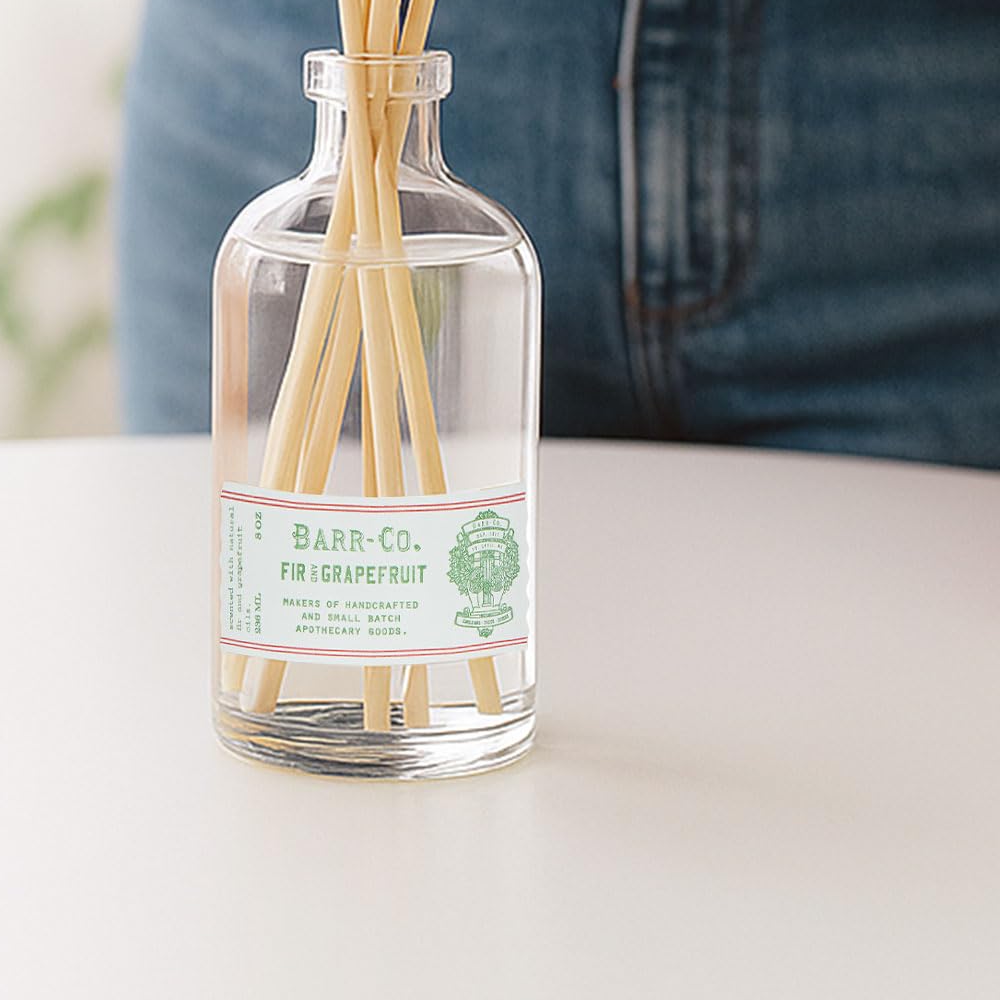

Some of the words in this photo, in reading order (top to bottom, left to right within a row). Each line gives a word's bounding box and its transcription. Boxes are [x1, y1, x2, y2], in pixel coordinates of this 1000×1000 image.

[254, 511, 262, 530] OZ
[254, 532, 262, 541] 8
[281, 562, 306, 582] FIR
[310, 564, 318, 582] AND
[321, 564, 427, 584] GRAPEFRUIT
[254, 593, 262, 612] ML
[282, 598, 320, 608] MAKERS
[326, 600, 340, 609] OF
[345, 600, 419, 610] HANDCRAFTED
[254, 615, 262, 634] 236
[301, 612, 321, 621] AND
[327, 613, 360, 623] SMALL
[368, 614, 401, 623] BATCH
[295, 624, 361, 635] APOTHECARY
[368, 627, 407, 636] GOODS.
